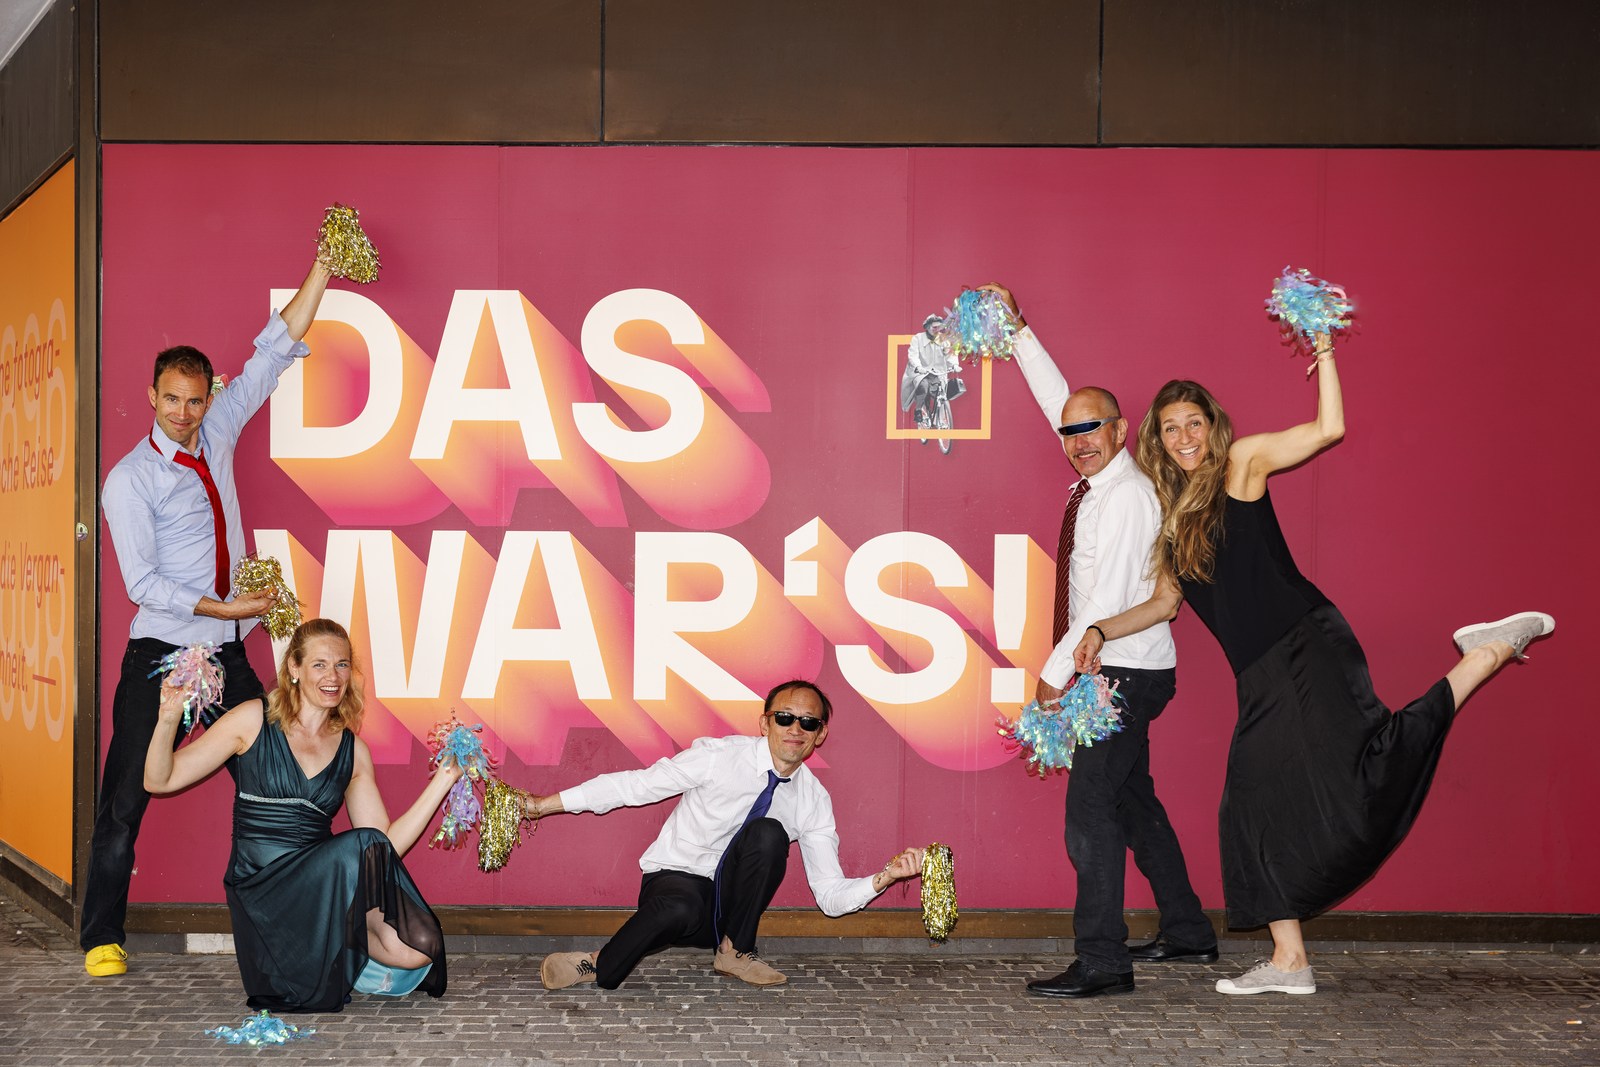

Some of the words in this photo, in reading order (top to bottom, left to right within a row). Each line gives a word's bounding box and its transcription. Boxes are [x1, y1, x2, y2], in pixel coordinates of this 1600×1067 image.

[12, 338, 60, 409] fotogra-
[270, 288, 705, 463] DAS
[0, 442, 19, 494] che
[23, 436, 54, 490] Reise
[1, 540, 16, 590] die
[20, 541, 65, 609] Vergan-
[253, 516, 1028, 705] WAR'S!
